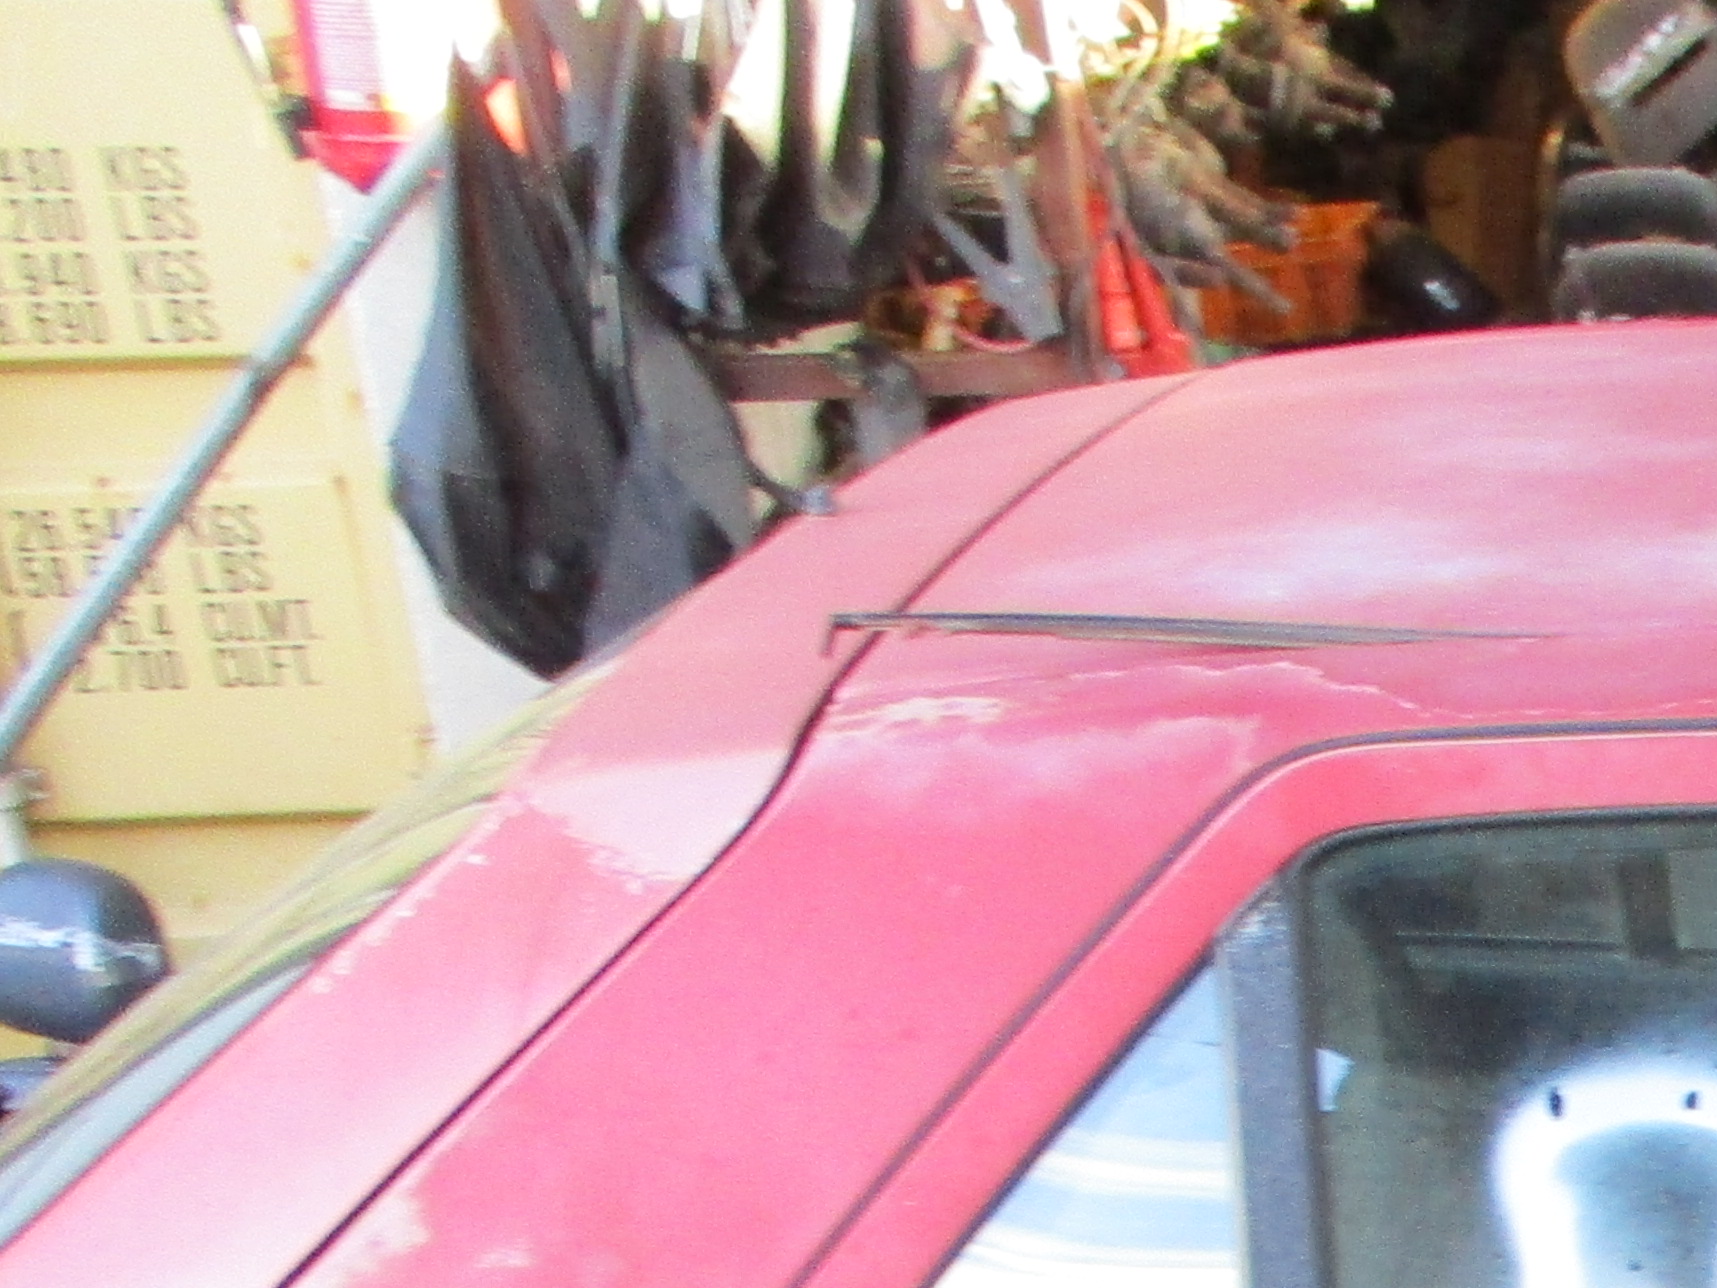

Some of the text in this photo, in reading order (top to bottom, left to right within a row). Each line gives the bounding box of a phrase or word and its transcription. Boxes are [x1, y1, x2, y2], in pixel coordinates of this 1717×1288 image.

[97, 146, 190, 192] KGS
[108, 195, 201, 241] LBS
[122, 249, 211, 295] KGS
[133, 298, 222, 344] LBS
[187, 549, 274, 593] LBS
